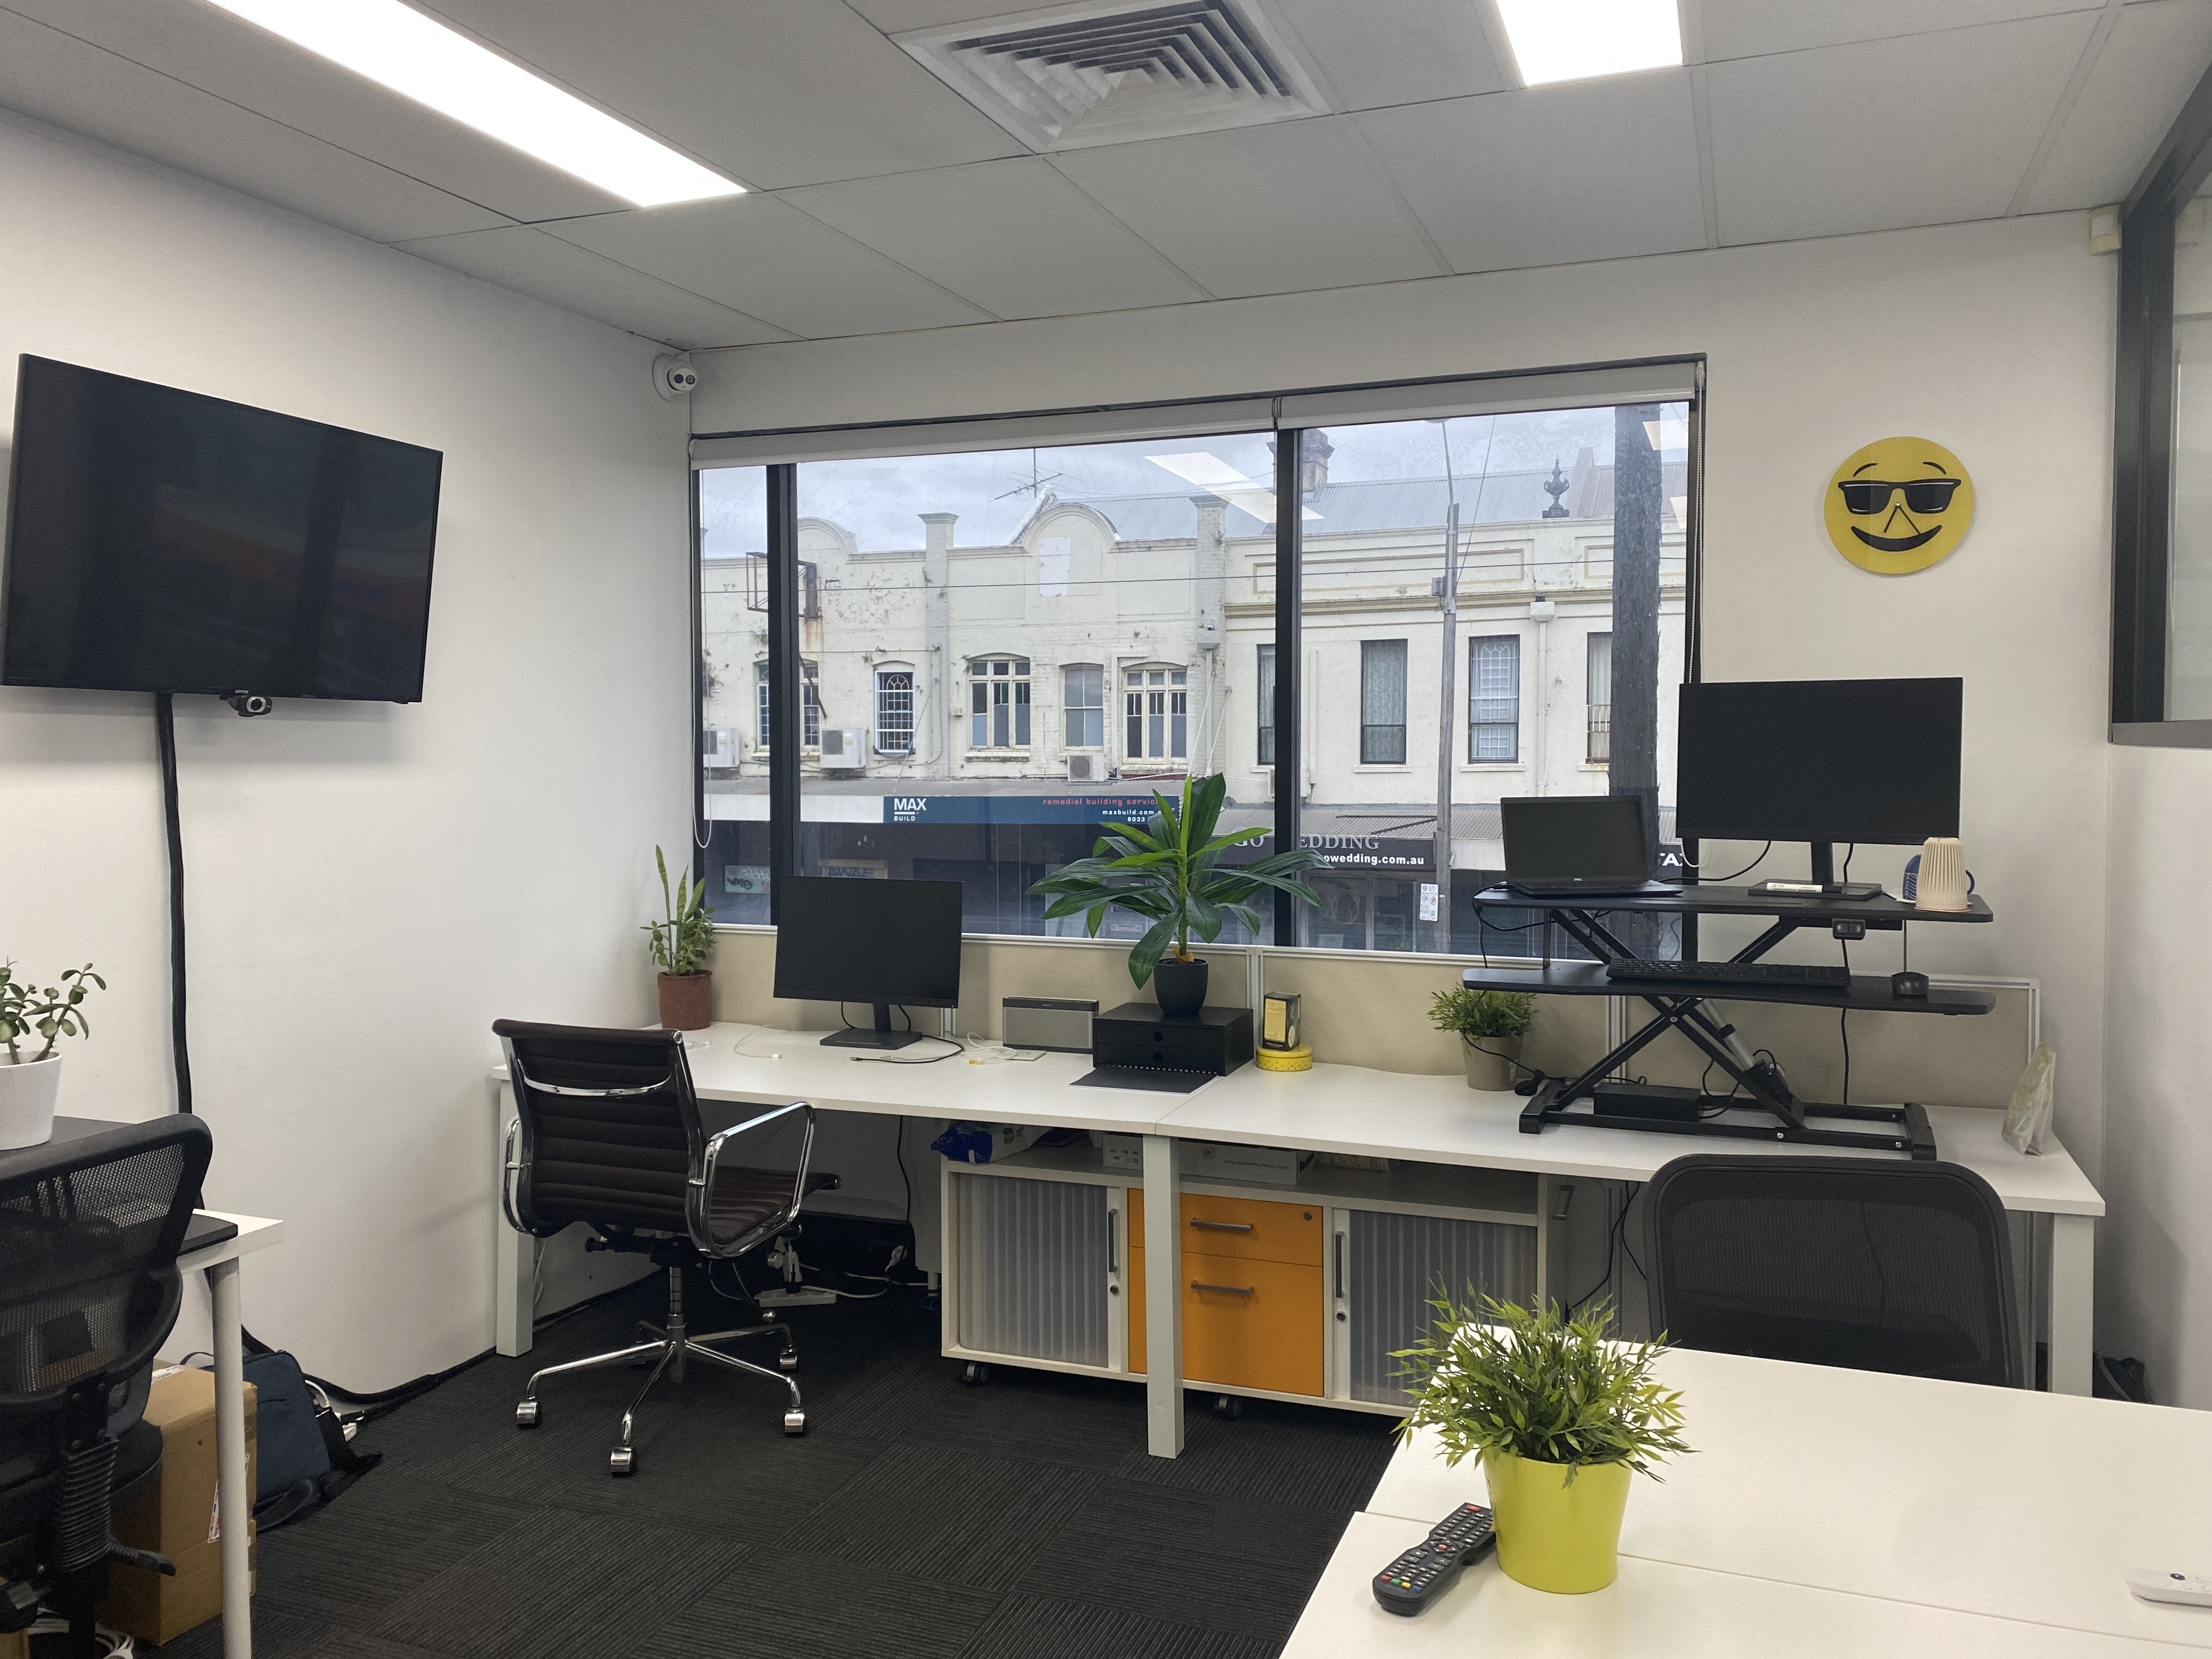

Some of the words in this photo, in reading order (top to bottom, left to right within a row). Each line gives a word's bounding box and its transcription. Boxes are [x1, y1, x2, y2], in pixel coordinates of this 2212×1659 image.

[894, 798, 927, 810] MAX
[1086, 798, 1122, 806] building
[1300, 834, 1380, 849] EDDING
[1323, 853, 1424, 866] owedding.com.au
